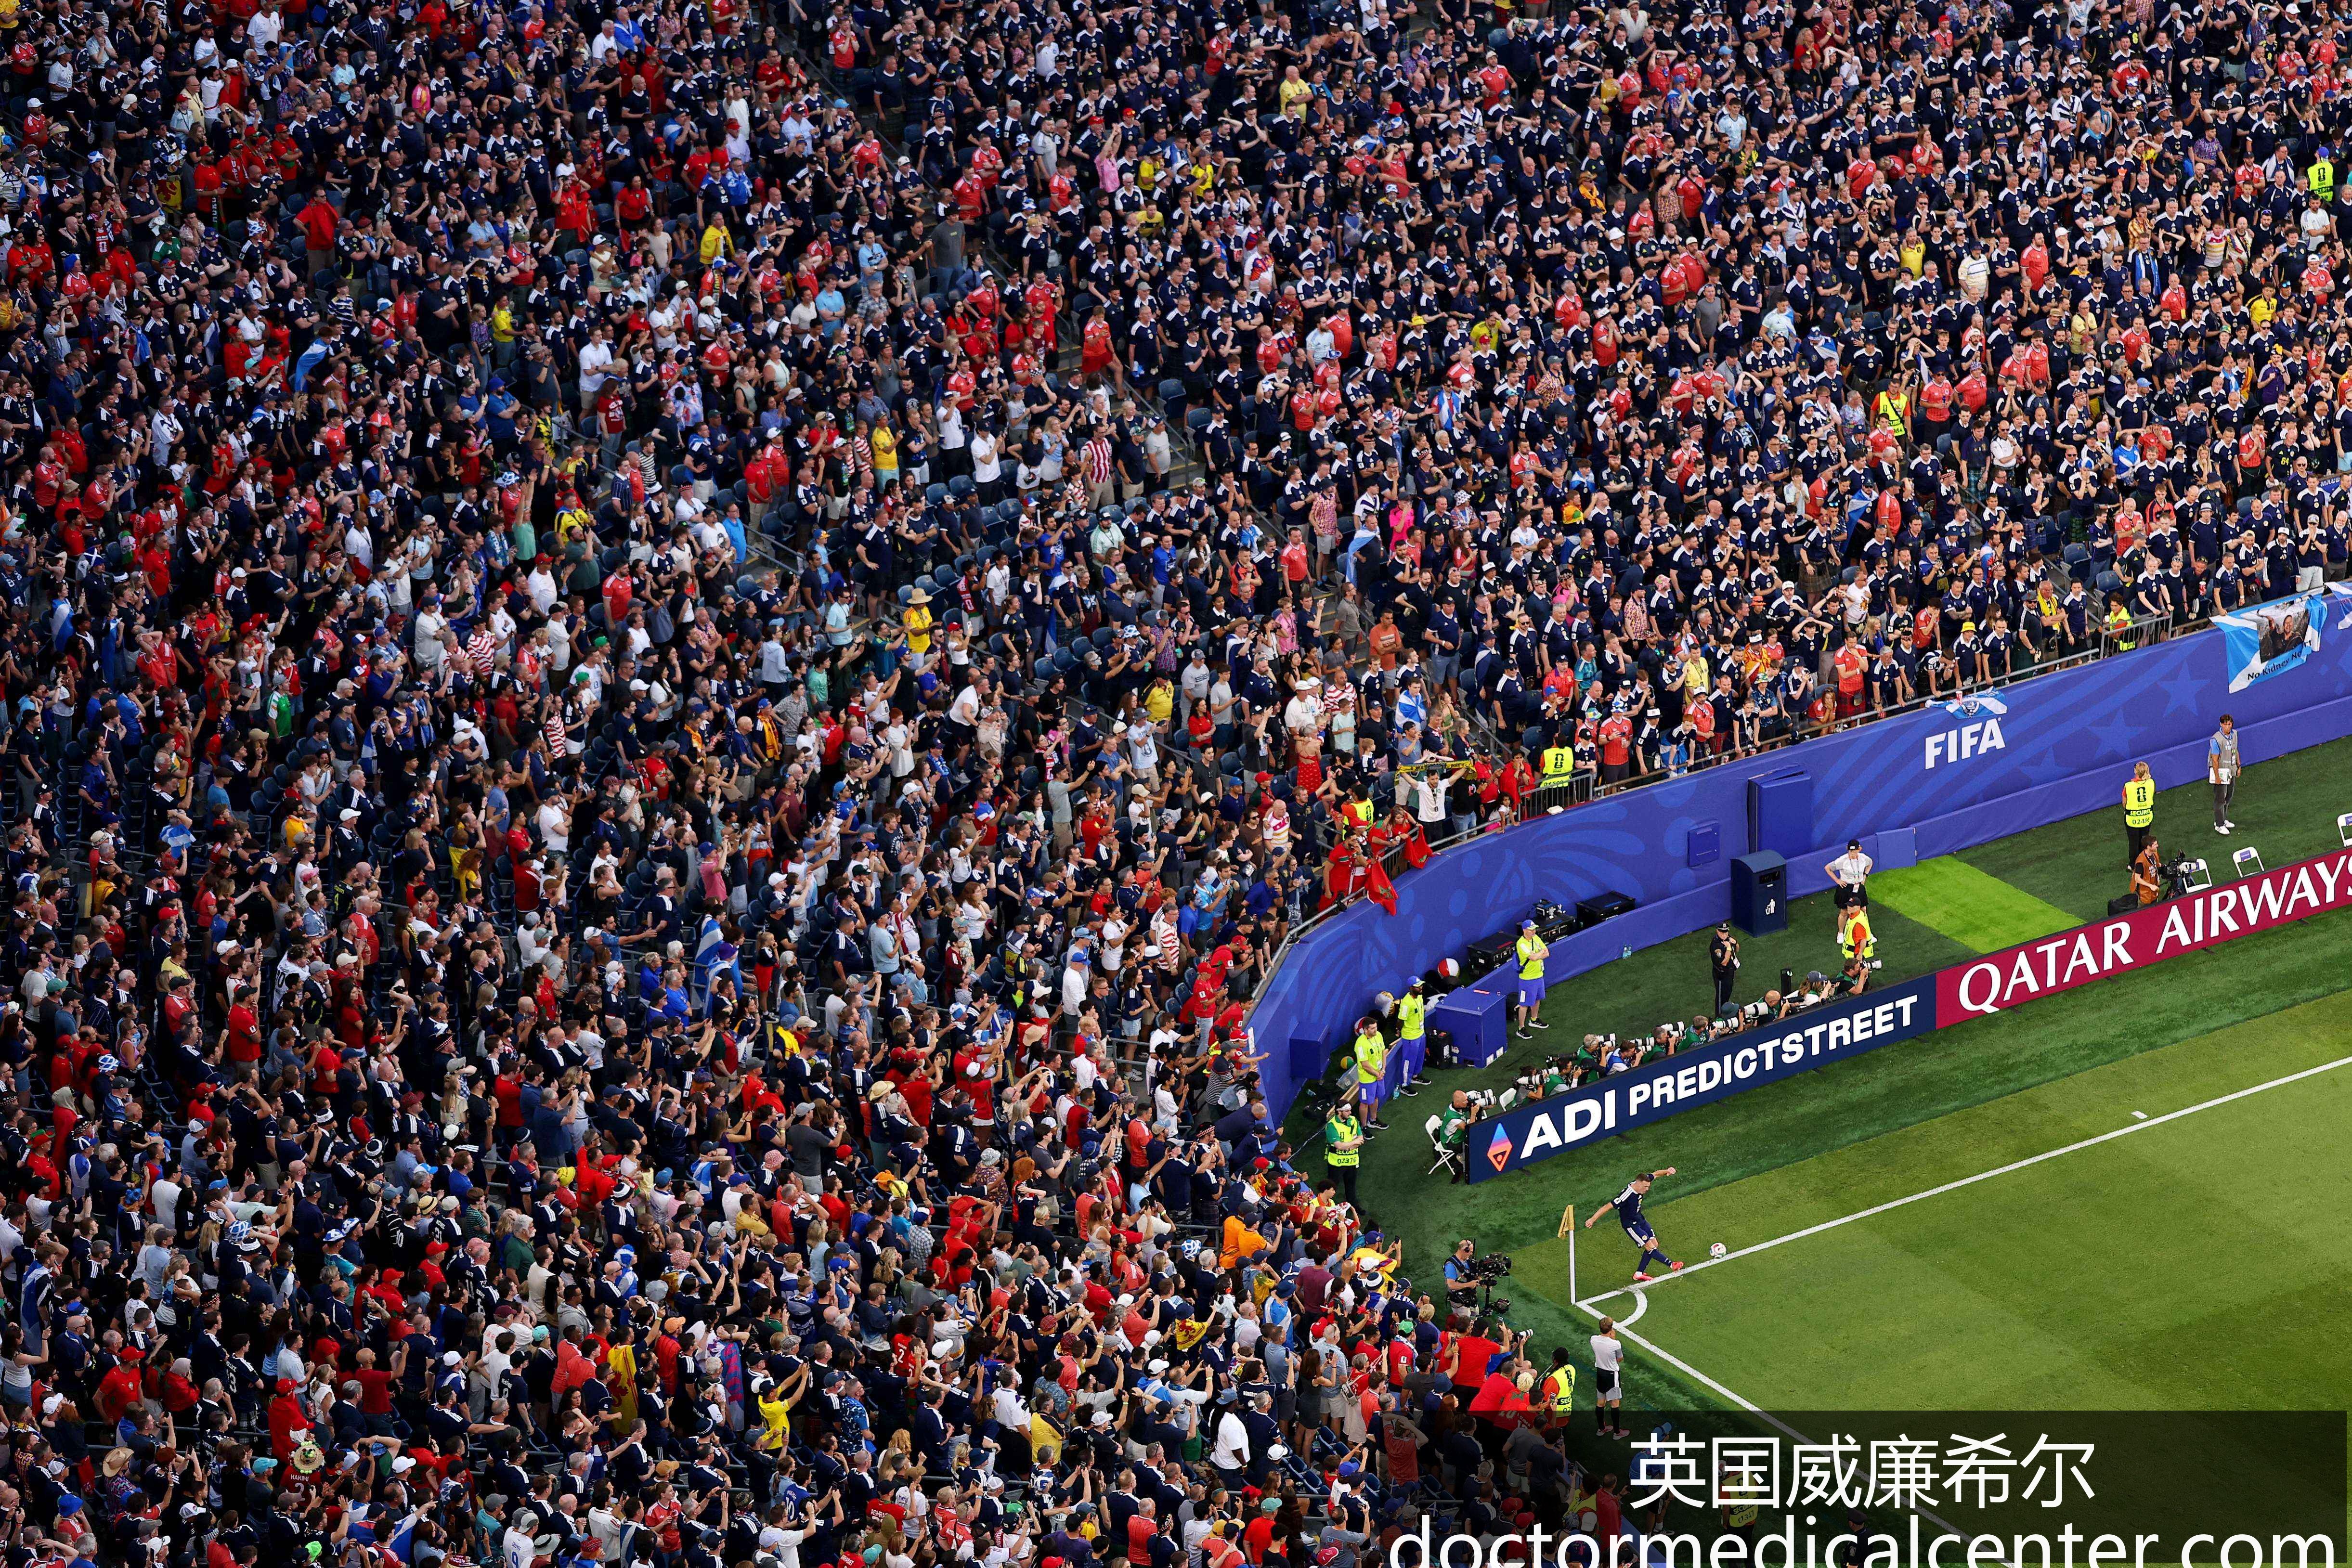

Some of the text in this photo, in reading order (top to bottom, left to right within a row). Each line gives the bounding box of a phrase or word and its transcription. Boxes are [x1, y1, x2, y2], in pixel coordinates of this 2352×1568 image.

[2247, 672, 2261, 681] No
[2262, 658, 2290, 675] Kidney
[1925, 718, 2006, 770] FIFA
[1959, 854, 2352, 1013] QATAR AIRWAY
[1520, 995, 1918, 1159] ADI PREDICTSTREET
[290, 1474, 310, 1482] HAKIMI
